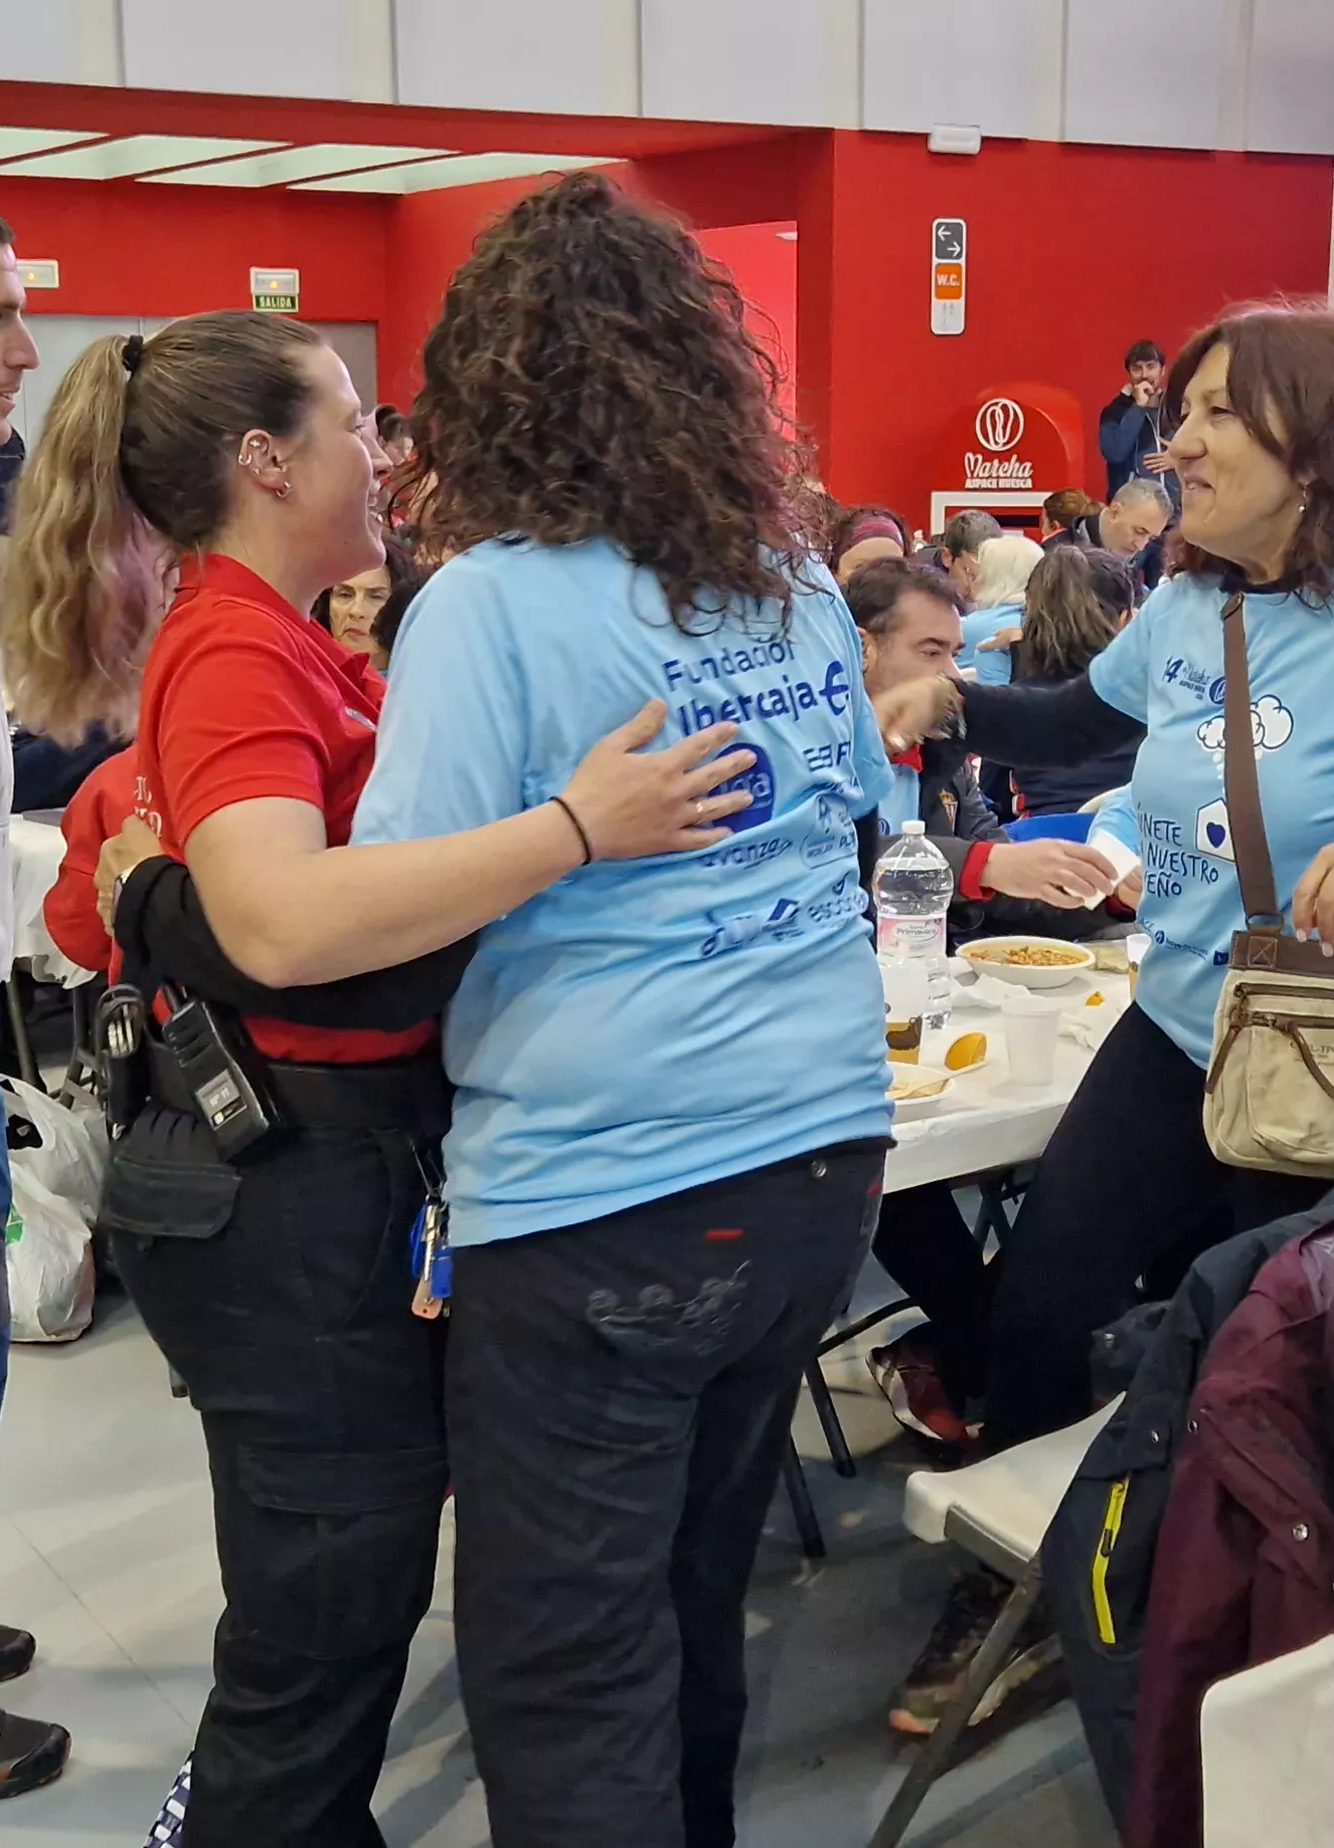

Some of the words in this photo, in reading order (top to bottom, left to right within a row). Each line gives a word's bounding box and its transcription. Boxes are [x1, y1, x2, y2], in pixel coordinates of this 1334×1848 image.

[937, 273, 960, 286] W.C.
[259, 296, 292, 308] SALIDA
[965, 452, 1034, 478] Marcha
[965, 478, 997, 488] ASPACE
[999, 478, 1032, 488] HUESCA
[677, 674, 819, 737] Ibercaja
[1148, 841, 1219, 885] NUESTRO
[1145, 871, 1182, 897] EÑO
